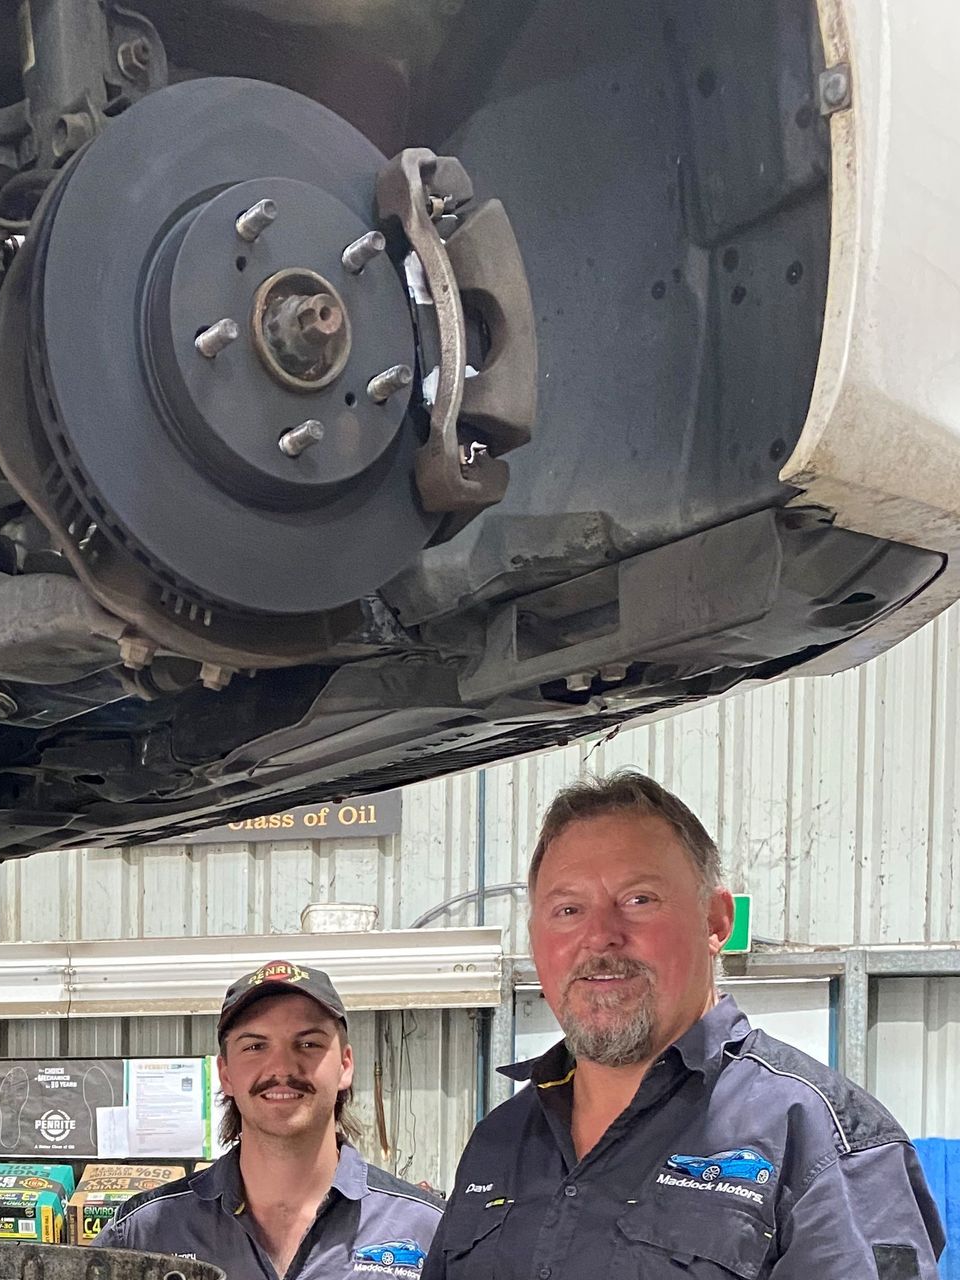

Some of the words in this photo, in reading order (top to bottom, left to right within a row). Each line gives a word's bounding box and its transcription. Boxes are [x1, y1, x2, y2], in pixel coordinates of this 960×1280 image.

[303, 807, 330, 827] of
[337, 805, 377, 825] Oil
[247, 965, 311, 985] PENRITE
[34, 1119, 77, 1130] PENRITE
[135, 1167, 172, 1179] 85%
[656, 1173, 716, 1191] Maddock
[84, 1217, 101, 1234] C4
[353, 1263, 394, 1275] Maddock
